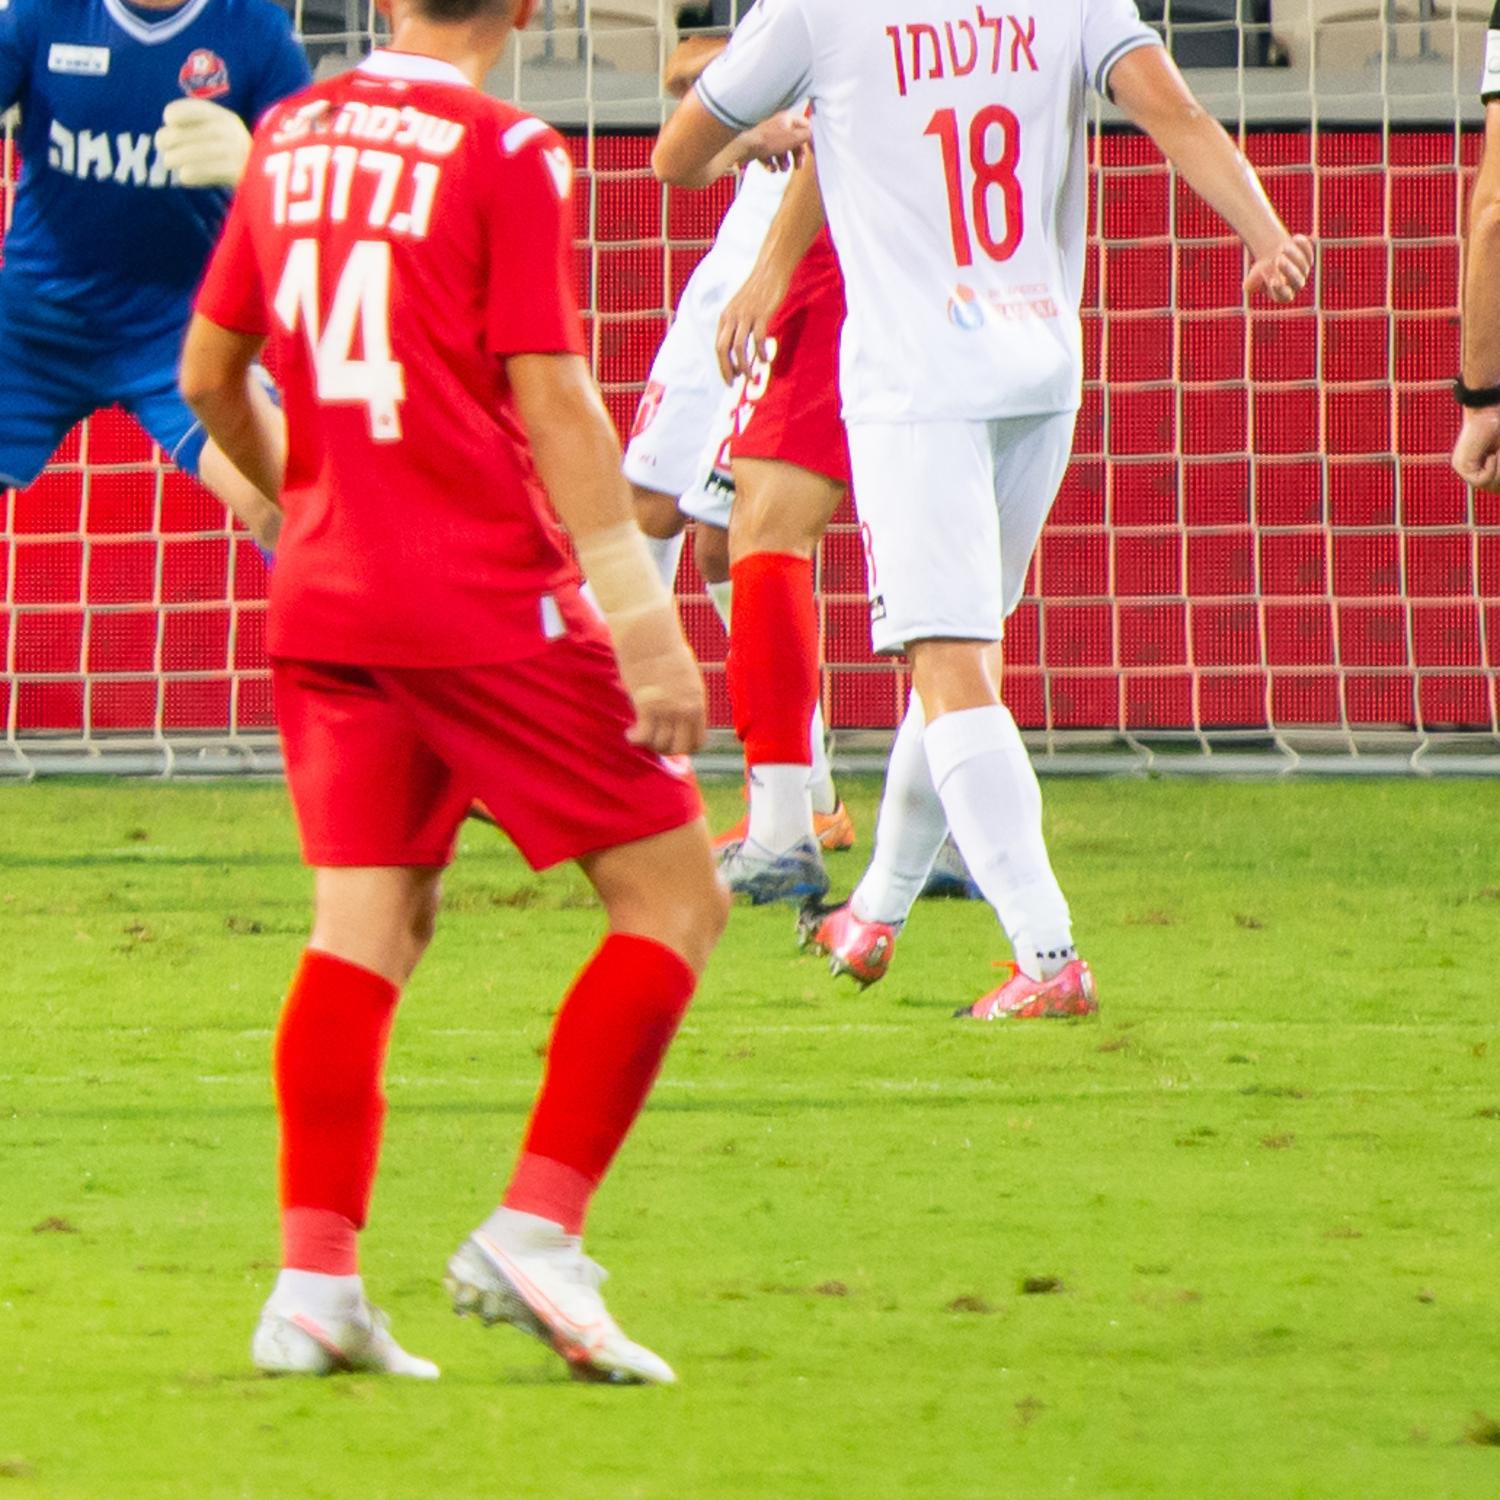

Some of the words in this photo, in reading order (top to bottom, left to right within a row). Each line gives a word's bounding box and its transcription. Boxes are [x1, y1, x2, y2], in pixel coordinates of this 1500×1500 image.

[886, 5, 1040, 98] אלטמן
[264, 144, 440, 239] גרופר
[922, 103, 1025, 268] 18
[273, 237, 406, 441] 14
